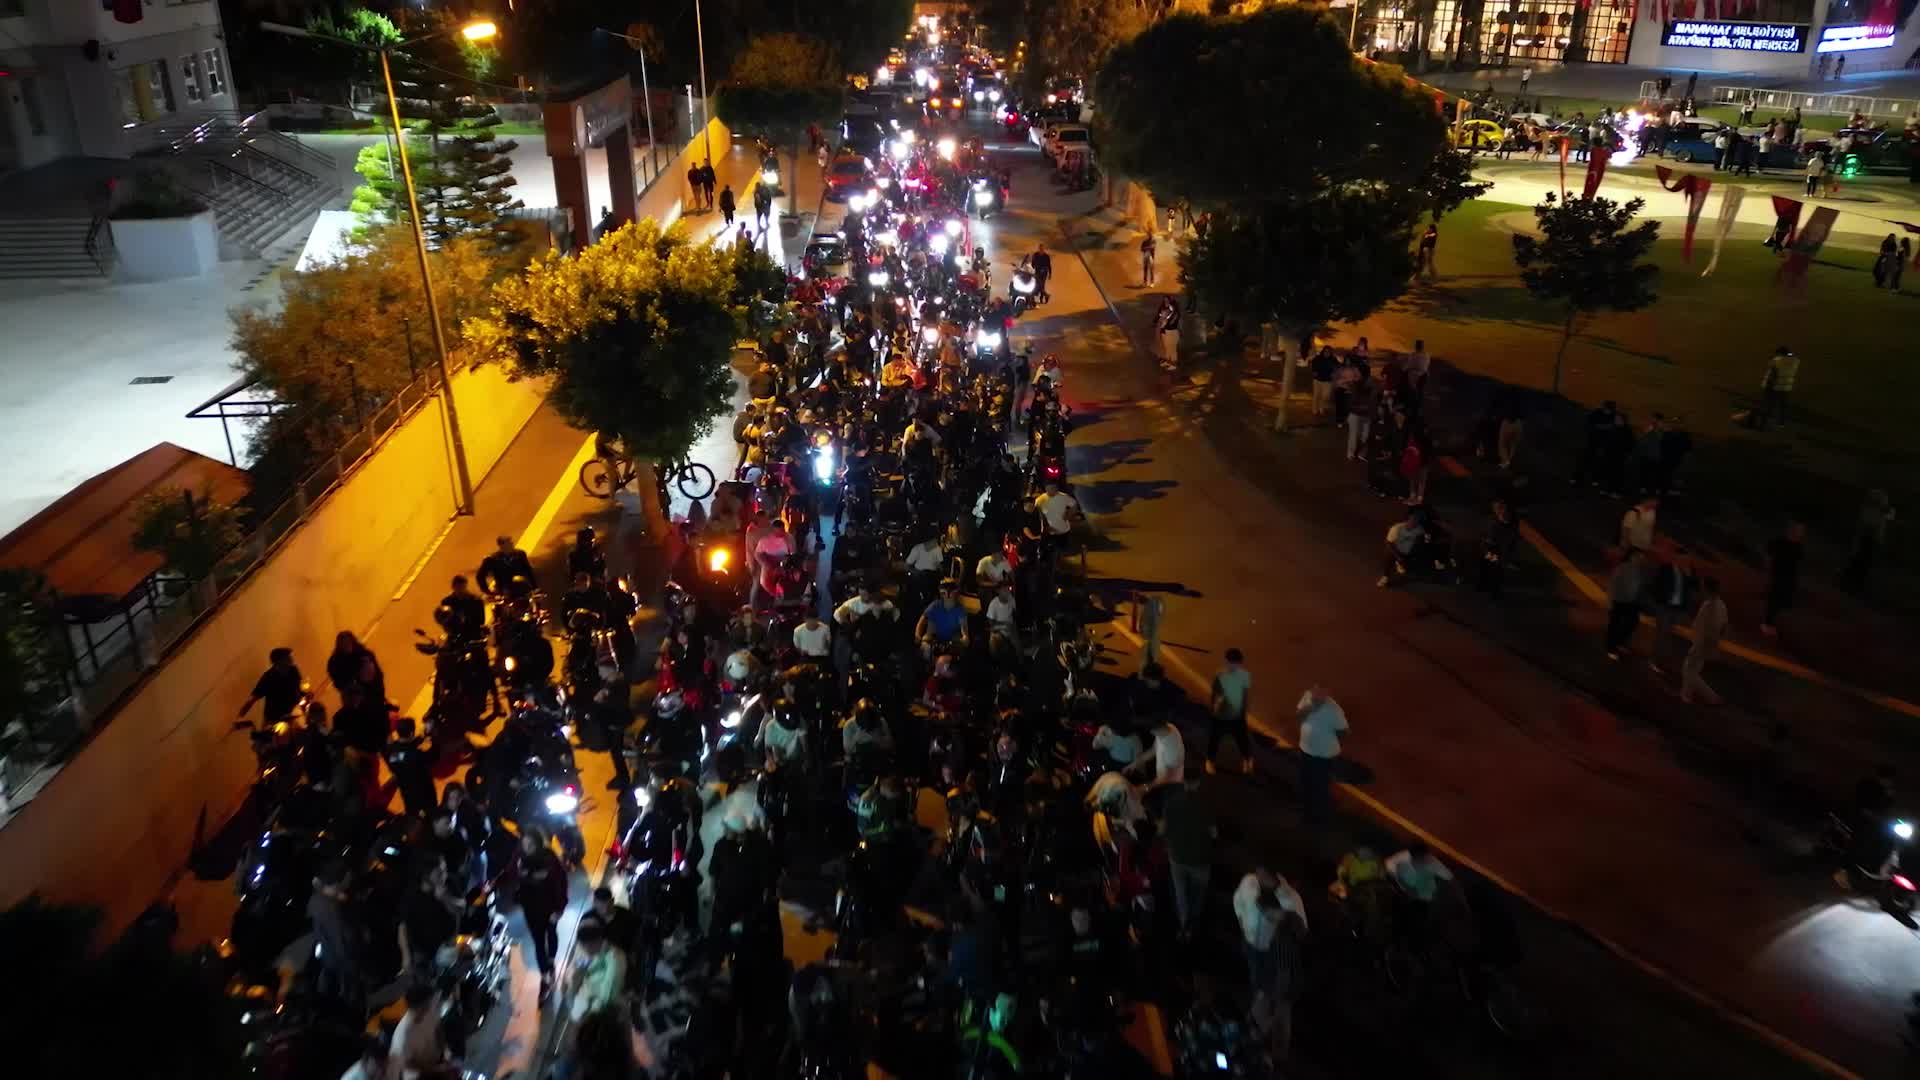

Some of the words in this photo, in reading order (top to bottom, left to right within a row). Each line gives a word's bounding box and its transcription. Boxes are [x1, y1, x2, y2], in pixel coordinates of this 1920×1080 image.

[1675, 23, 1731, 35] MANAVGAT
[1733, 25, 1796, 38] BELEDİYESİ
[1668, 35, 1711, 47] ATATÜRK
[1712, 36, 1751, 49] KÜLTÜR
[1752, 38, 1799, 51] MERKEZİ
